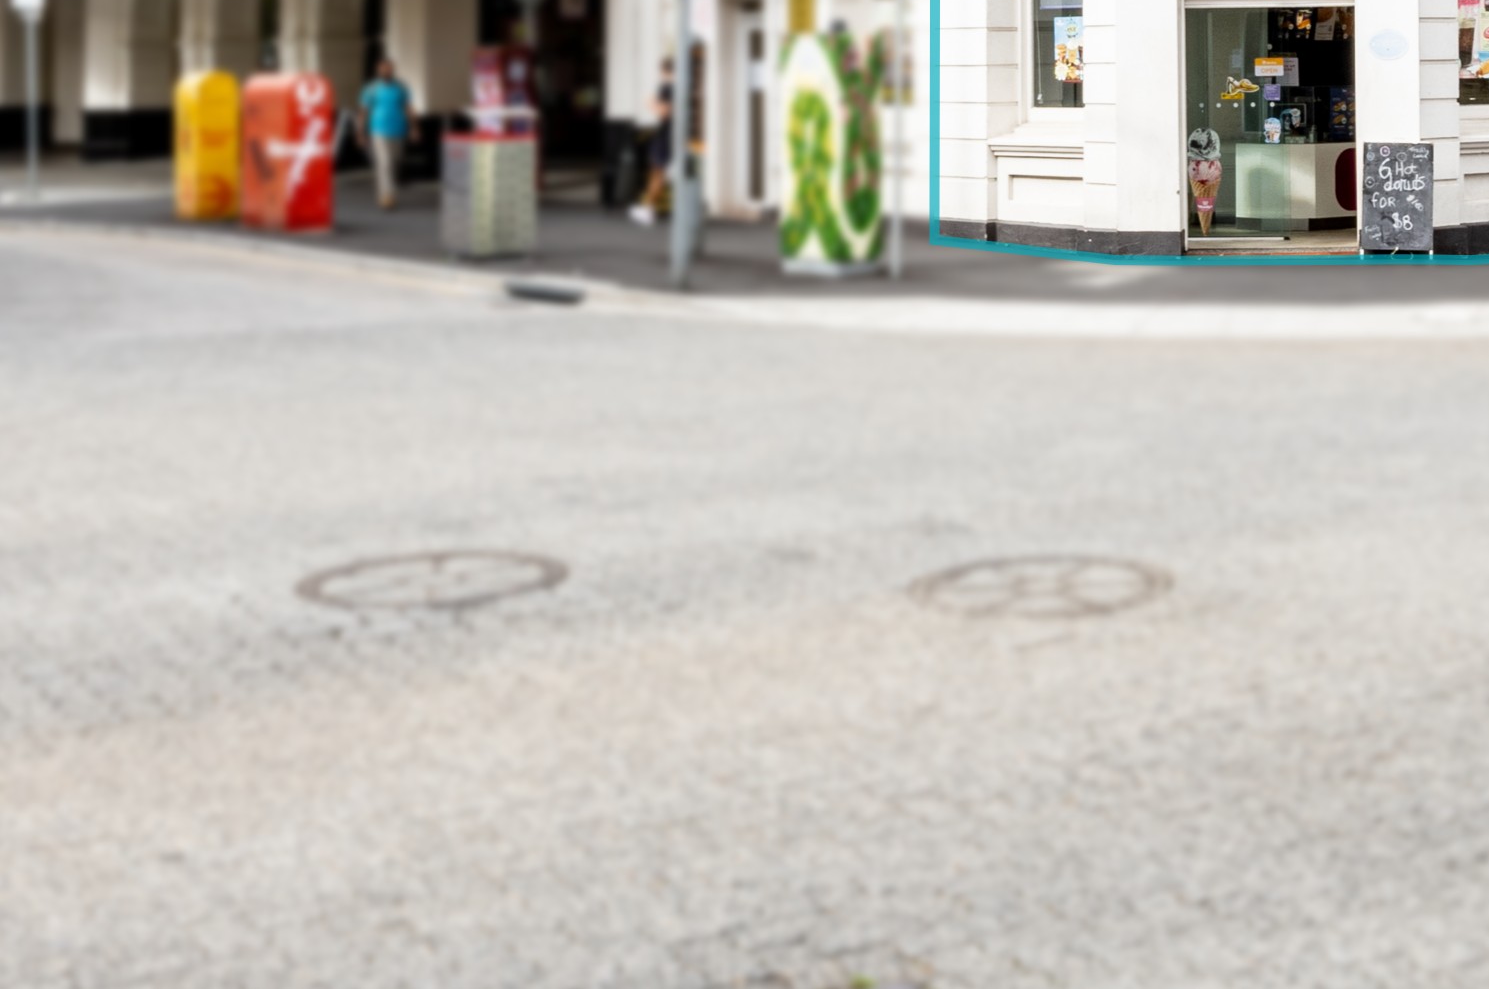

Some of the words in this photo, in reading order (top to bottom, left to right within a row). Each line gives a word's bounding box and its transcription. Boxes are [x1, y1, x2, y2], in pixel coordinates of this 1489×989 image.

[1378, 158, 1392, 180] 6
[1395, 161, 1418, 177] Hot
[1383, 174, 1426, 191] donuts
[1391, 212, 1413, 231] $8
